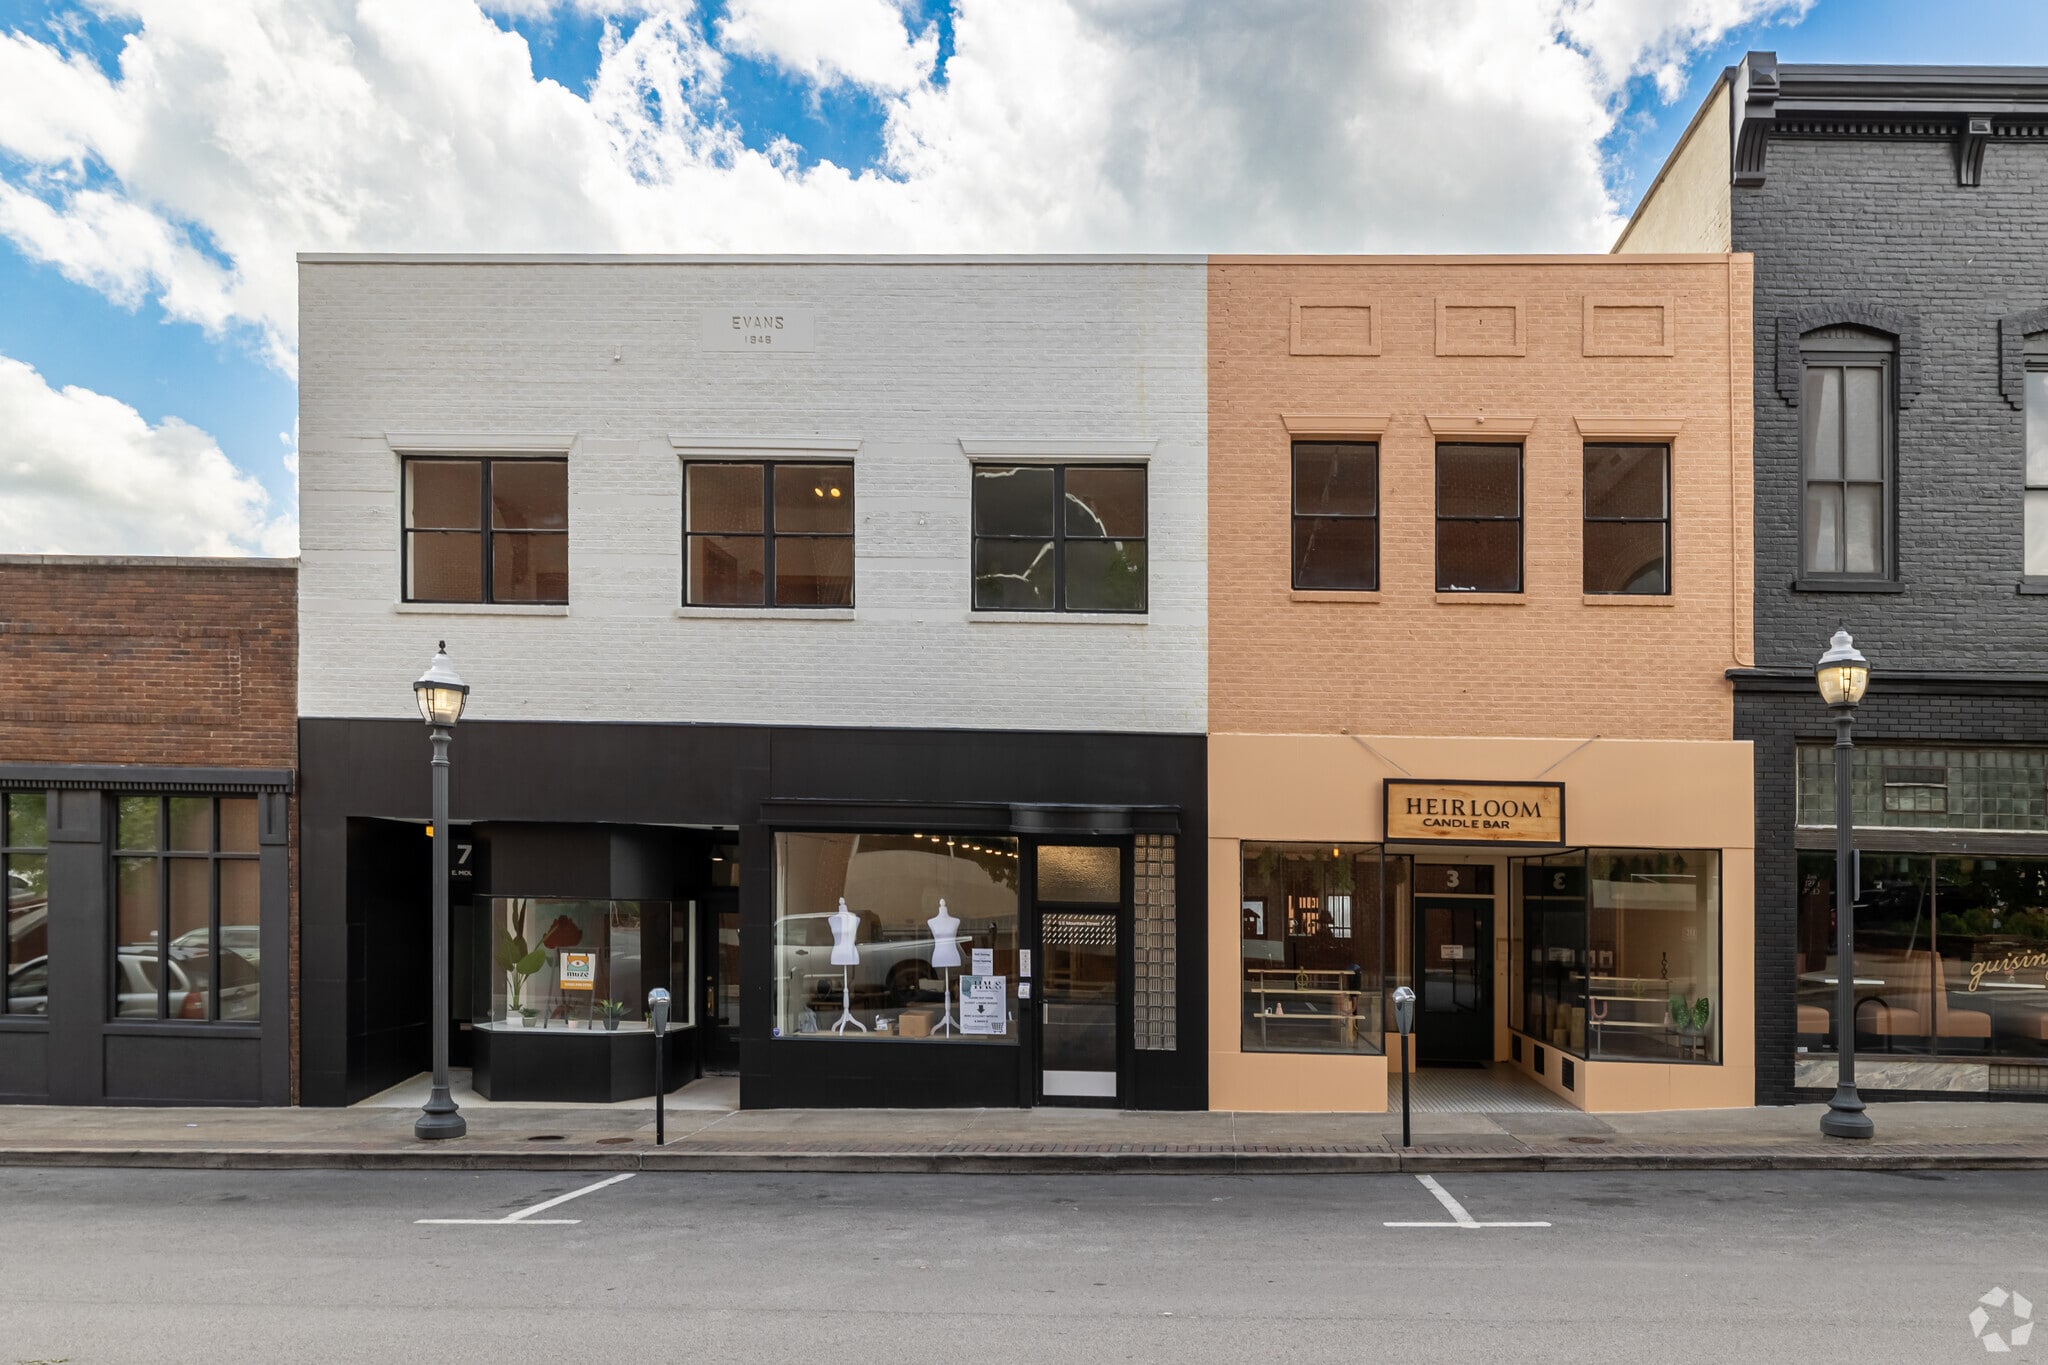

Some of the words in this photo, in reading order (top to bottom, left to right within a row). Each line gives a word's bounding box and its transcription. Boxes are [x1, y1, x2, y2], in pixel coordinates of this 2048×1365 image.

[732, 316, 784, 329] EVANS
[1406, 798, 1542, 817] HEIRLOOM
[1422, 818, 1479, 829] CANDLE
[1483, 820, 1510, 829] BAR
[457, 844, 473, 864] 7
[1446, 869, 1460, 888] 3
[1968, 949, 2048, 993] guisin
